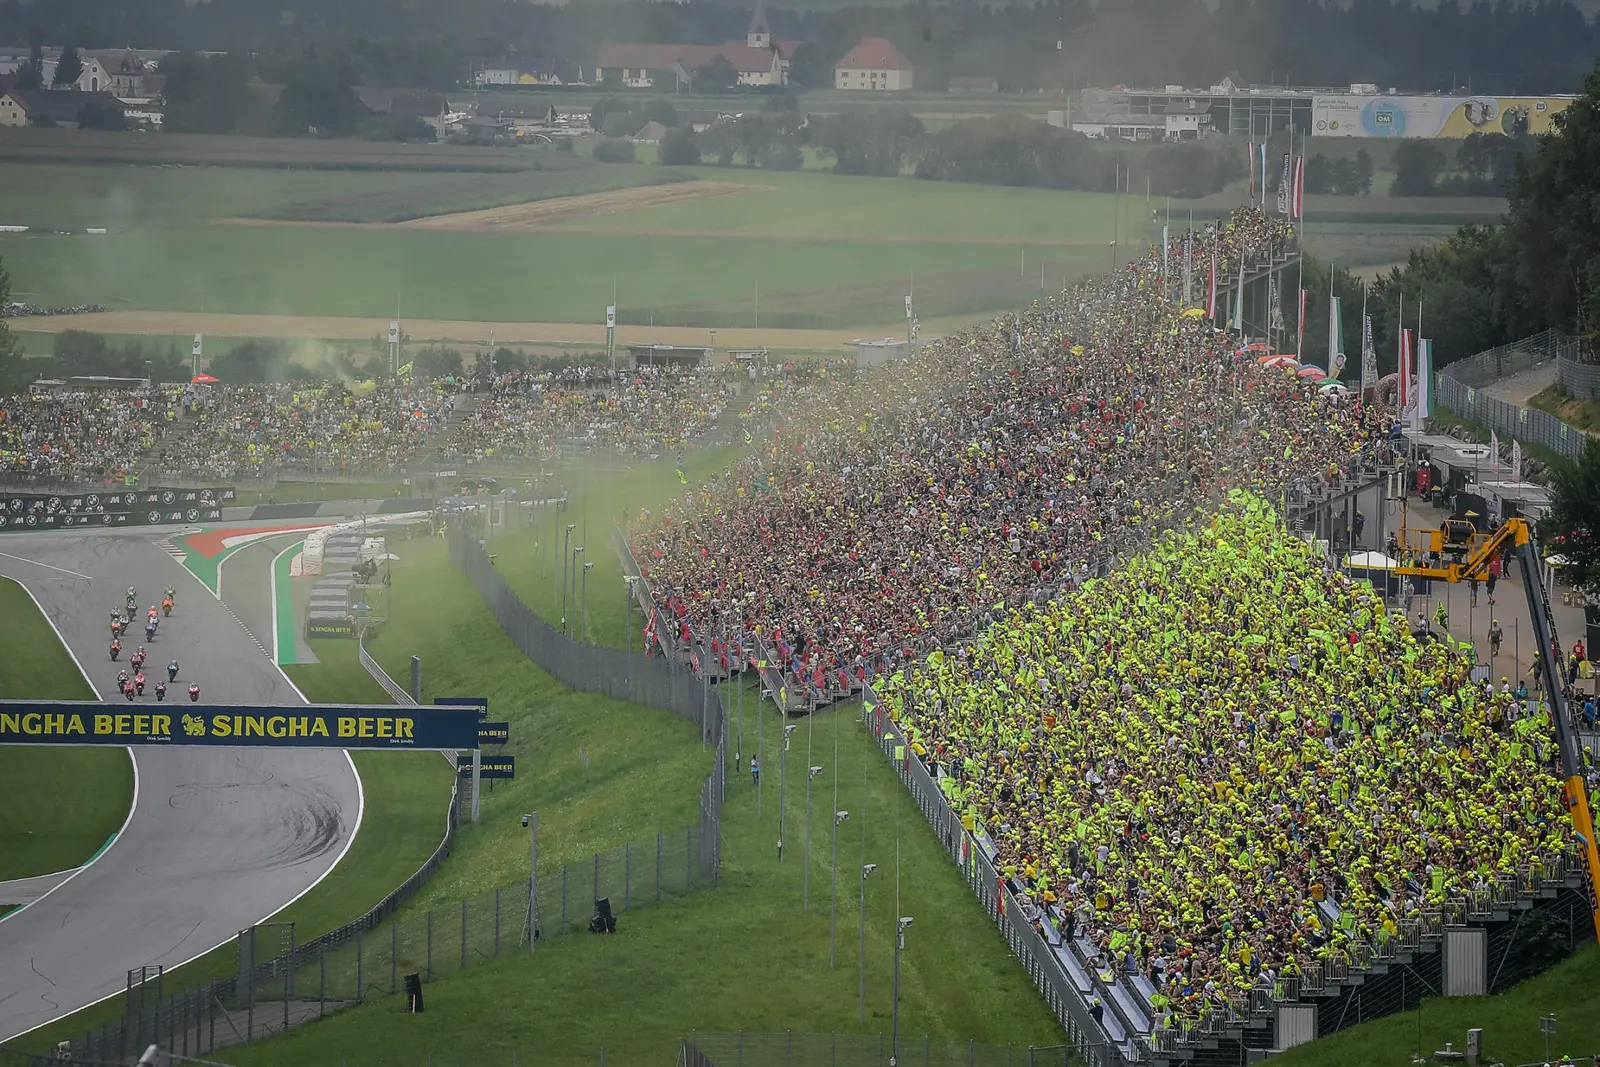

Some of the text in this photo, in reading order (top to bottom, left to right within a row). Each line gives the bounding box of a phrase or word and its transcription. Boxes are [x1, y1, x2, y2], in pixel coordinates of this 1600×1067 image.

[94, 714, 171, 735] BEER
[211, 715, 329, 738] SINGHA
[337, 717, 414, 738] BEER
